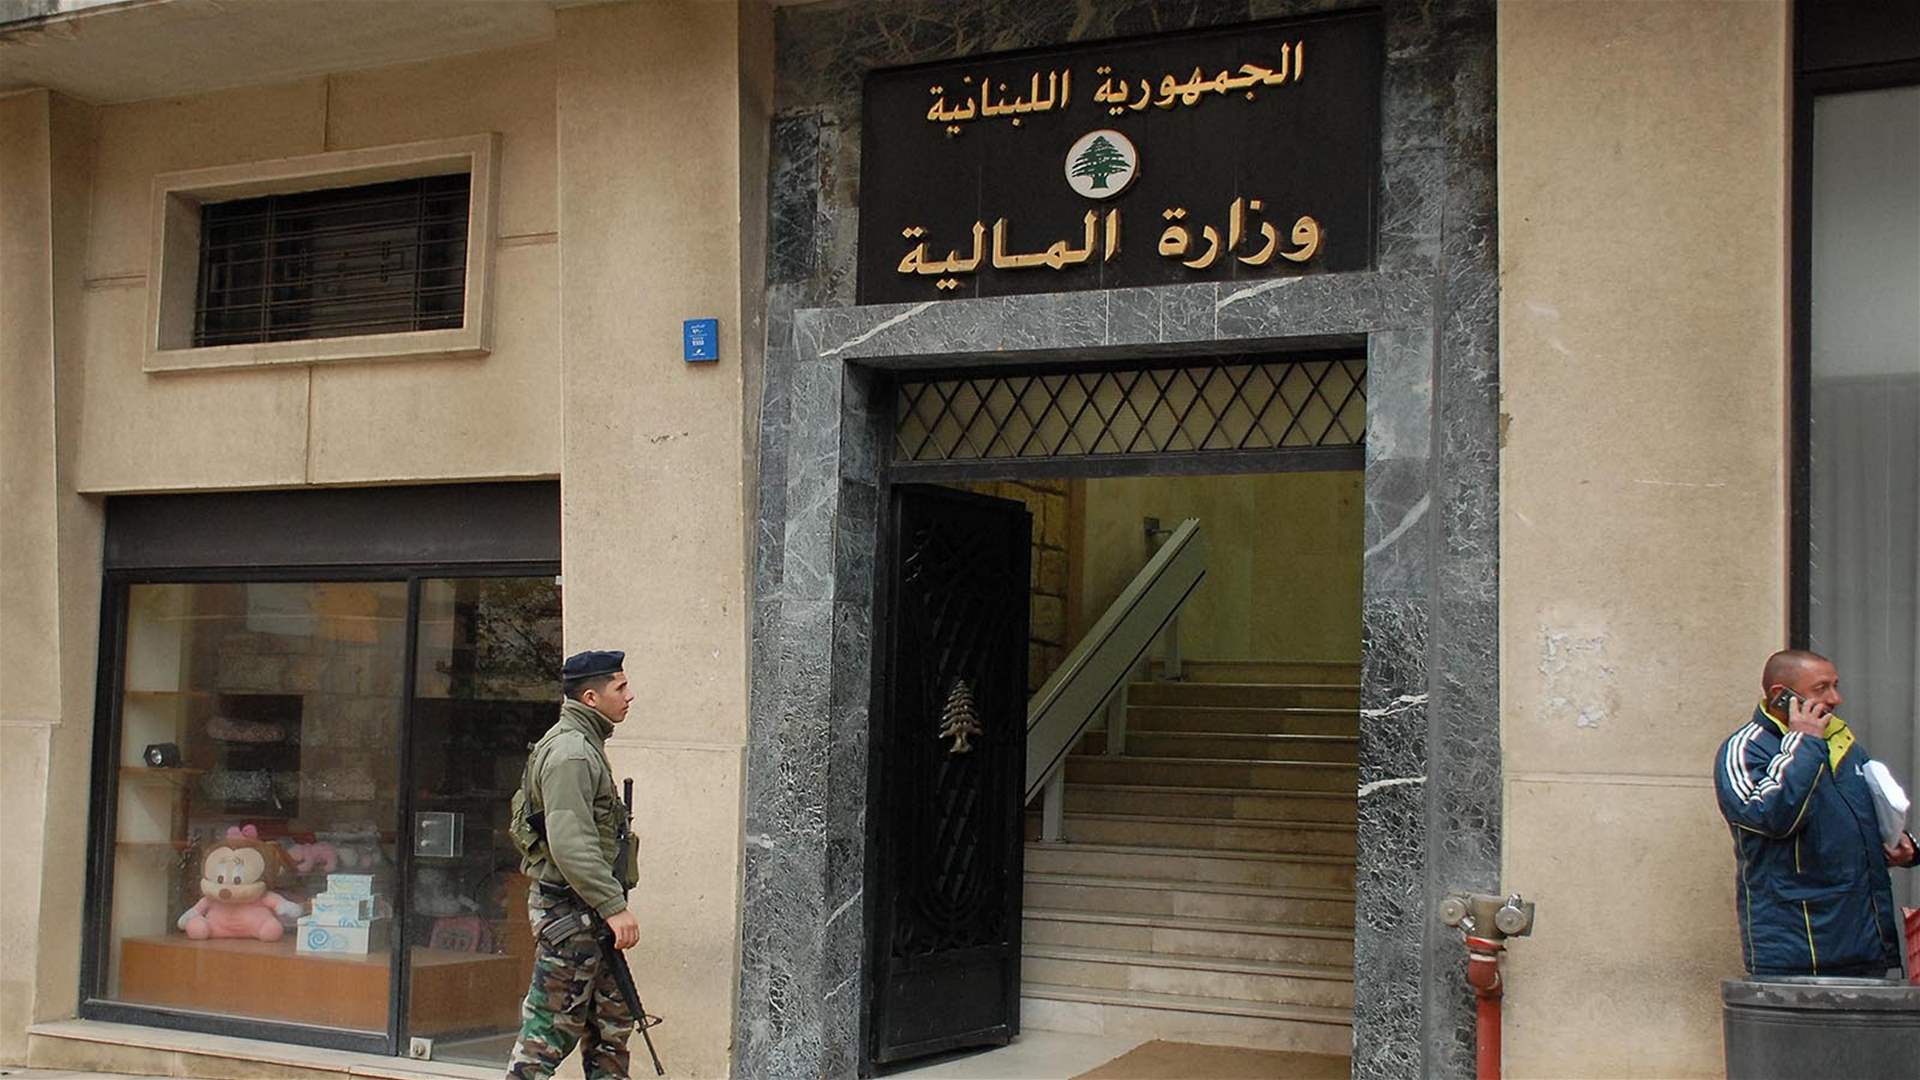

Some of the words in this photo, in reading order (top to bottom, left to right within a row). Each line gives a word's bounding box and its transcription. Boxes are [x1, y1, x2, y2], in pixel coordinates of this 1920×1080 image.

[926, 68, 1070, 136] اللبنانية
[1092, 40, 1303, 116] الجمهورية
[897, 208, 1119, 291] المالية
[1157, 197, 1323, 270] وزارة
